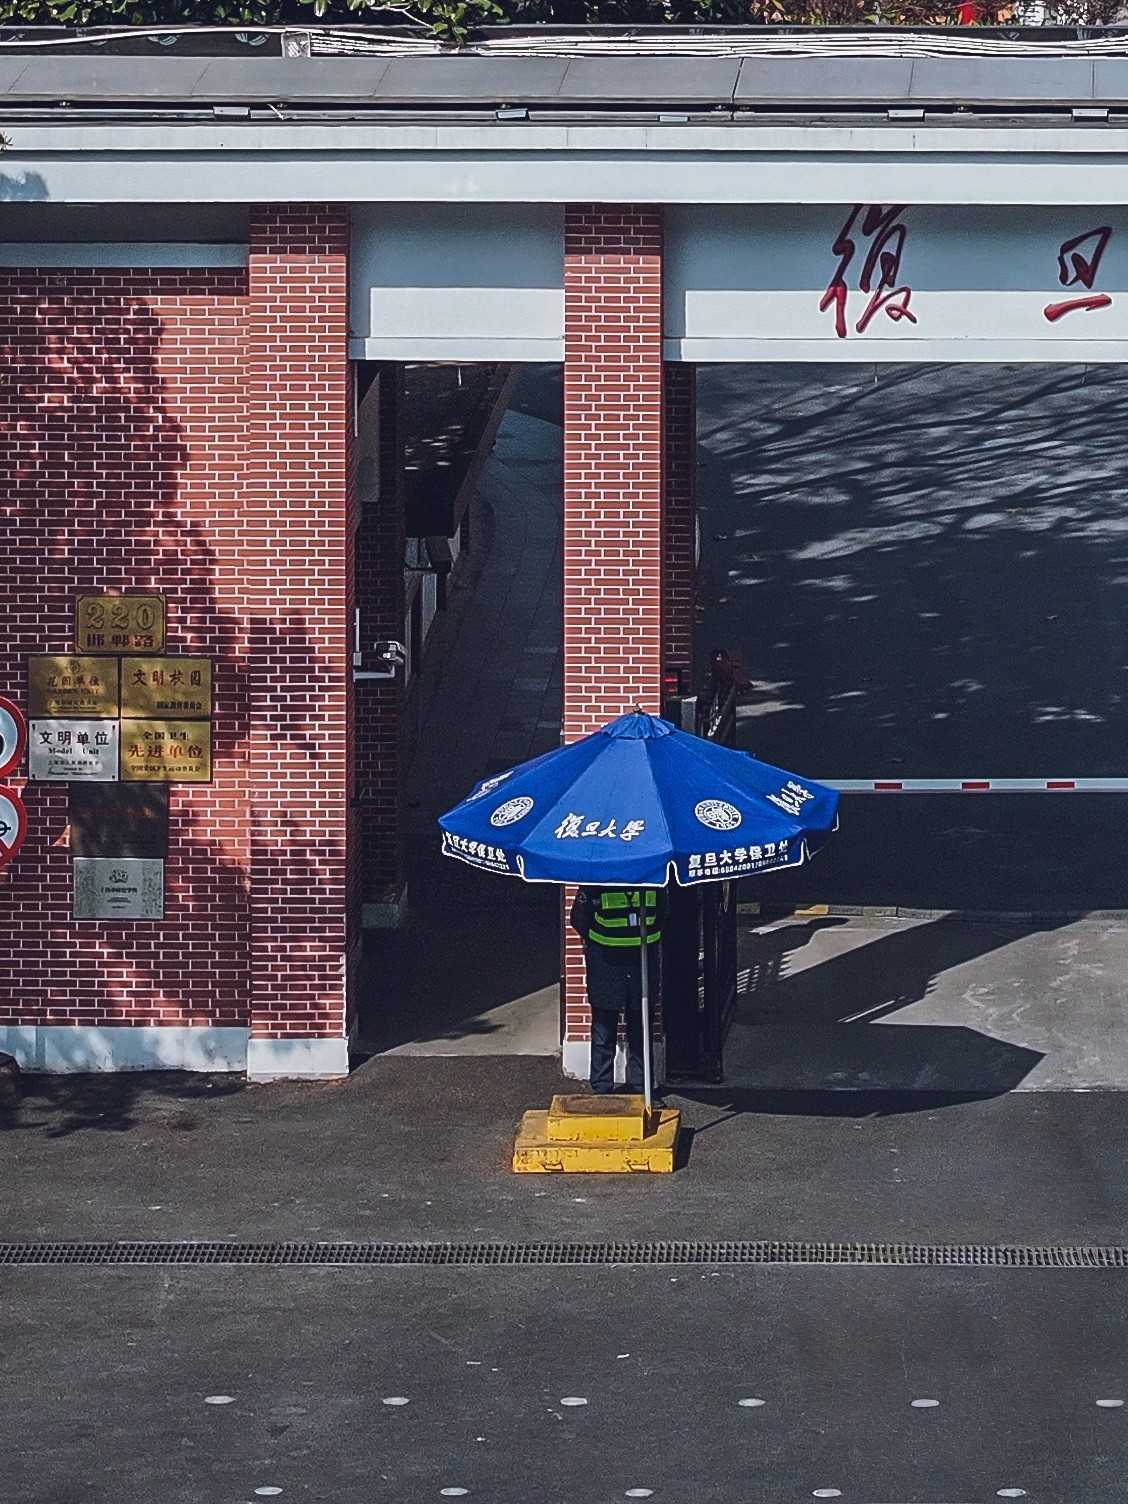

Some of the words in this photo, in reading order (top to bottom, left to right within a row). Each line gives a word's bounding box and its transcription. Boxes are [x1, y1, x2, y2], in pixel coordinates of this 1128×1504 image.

[86, 602, 155, 631] 220
[86, 634, 154, 647] 邯郸路
[39, 730, 109, 746] 文明单位
[127, 744, 203, 759] 先进单位
[688, 839, 789, 869] 复旦大学保卫处
